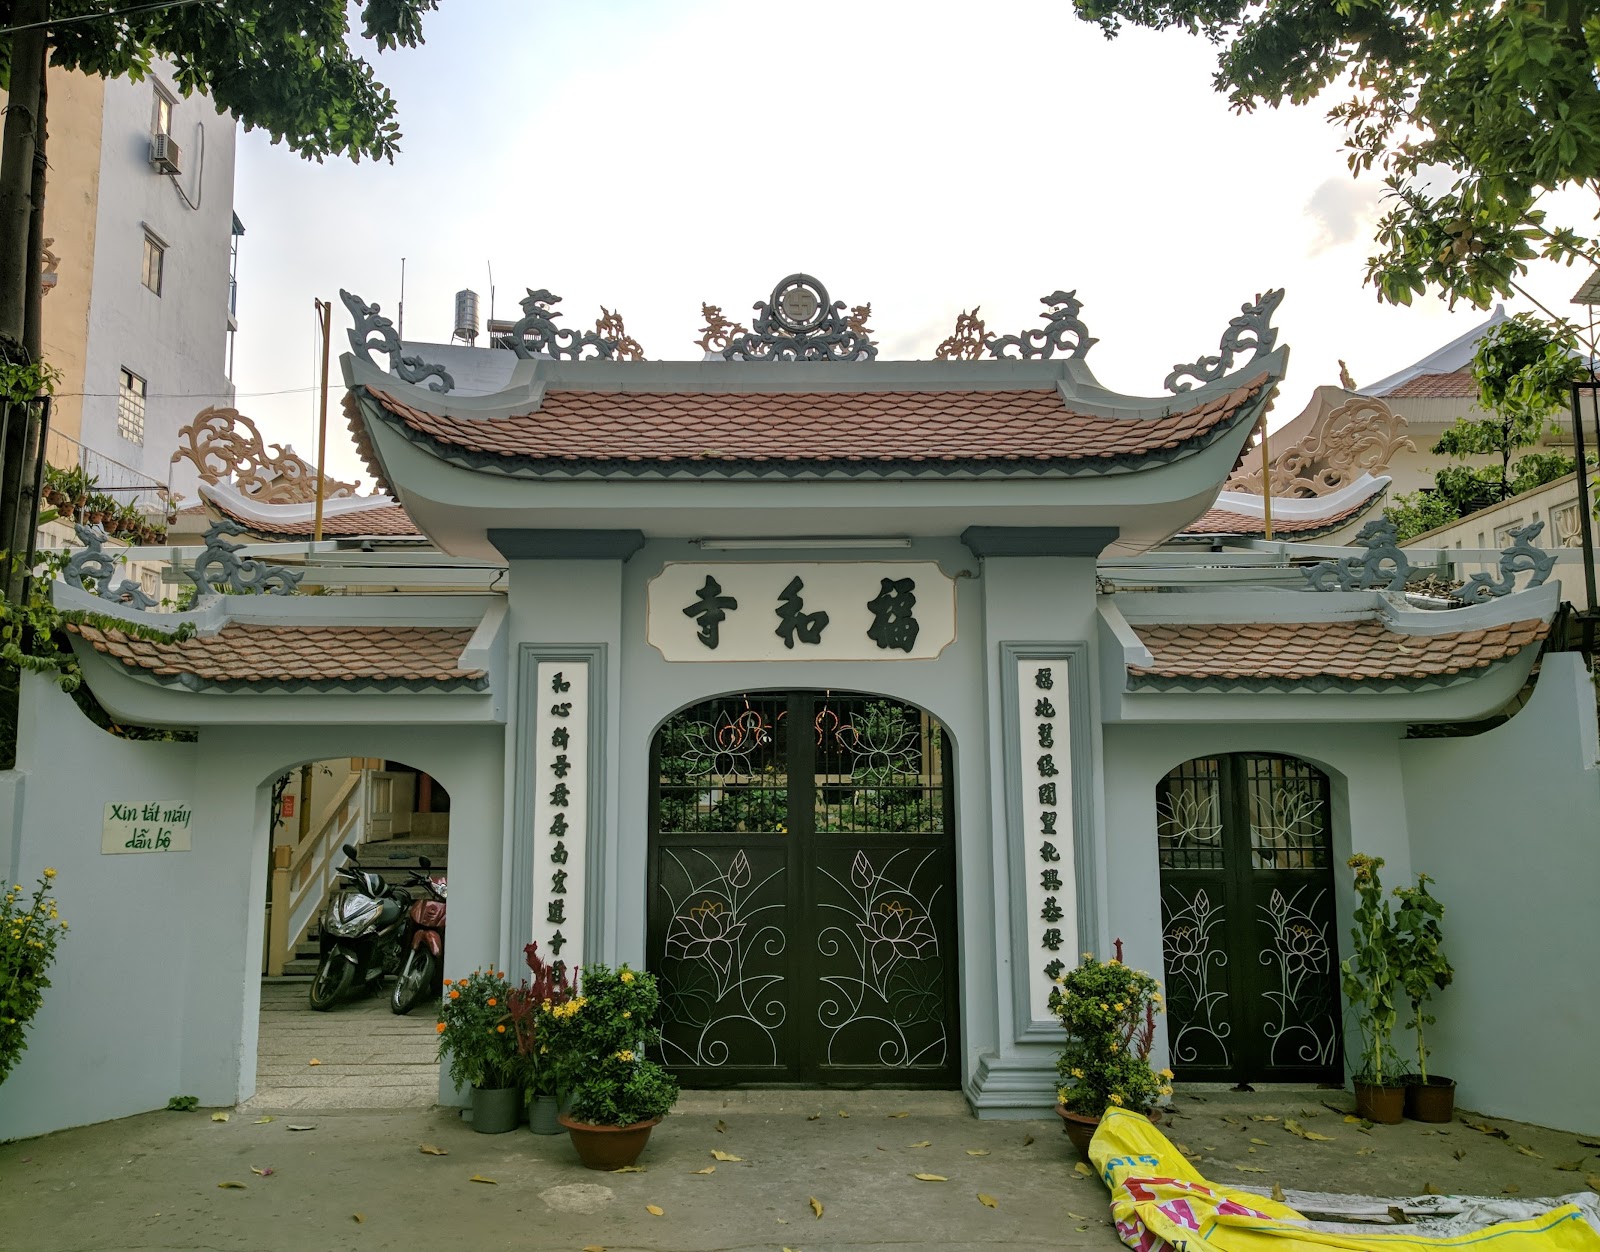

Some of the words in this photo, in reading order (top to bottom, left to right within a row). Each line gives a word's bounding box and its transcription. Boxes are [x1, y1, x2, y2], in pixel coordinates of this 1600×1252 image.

[110, 804, 138, 822] Xin
[141, 802, 160, 822] tắt
[163, 804, 192, 829] máy
[125, 827, 153, 850] dẫn
[155, 827, 172, 852] bộ
